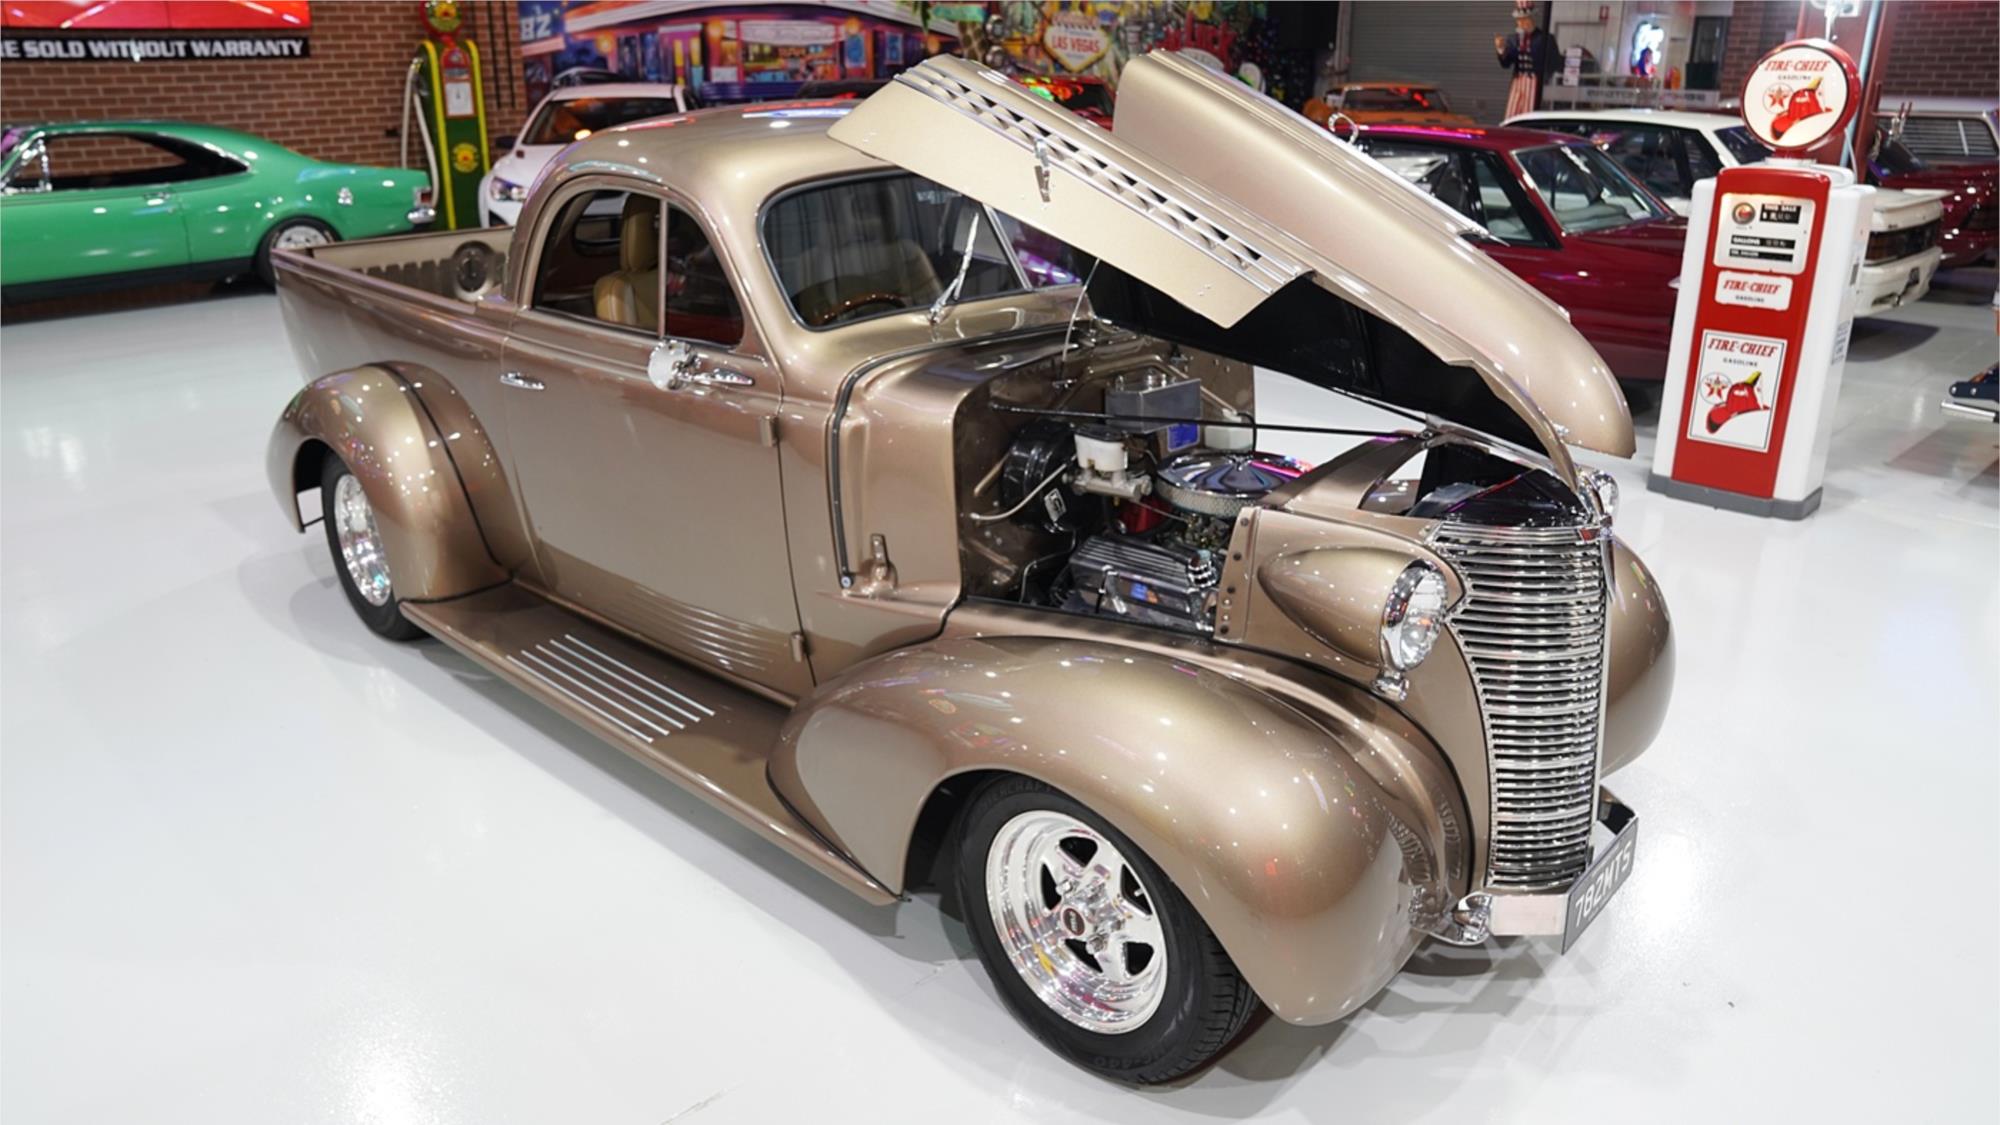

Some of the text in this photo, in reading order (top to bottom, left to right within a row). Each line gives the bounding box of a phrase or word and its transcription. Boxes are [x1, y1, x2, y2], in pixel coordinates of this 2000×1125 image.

[22, 40, 86, 58] SOLD
[88, 39, 187, 59] WITHOUT
[190, 39, 303, 57] WARRANTY
[1052, 34, 1100, 54] LAS VEGAS
